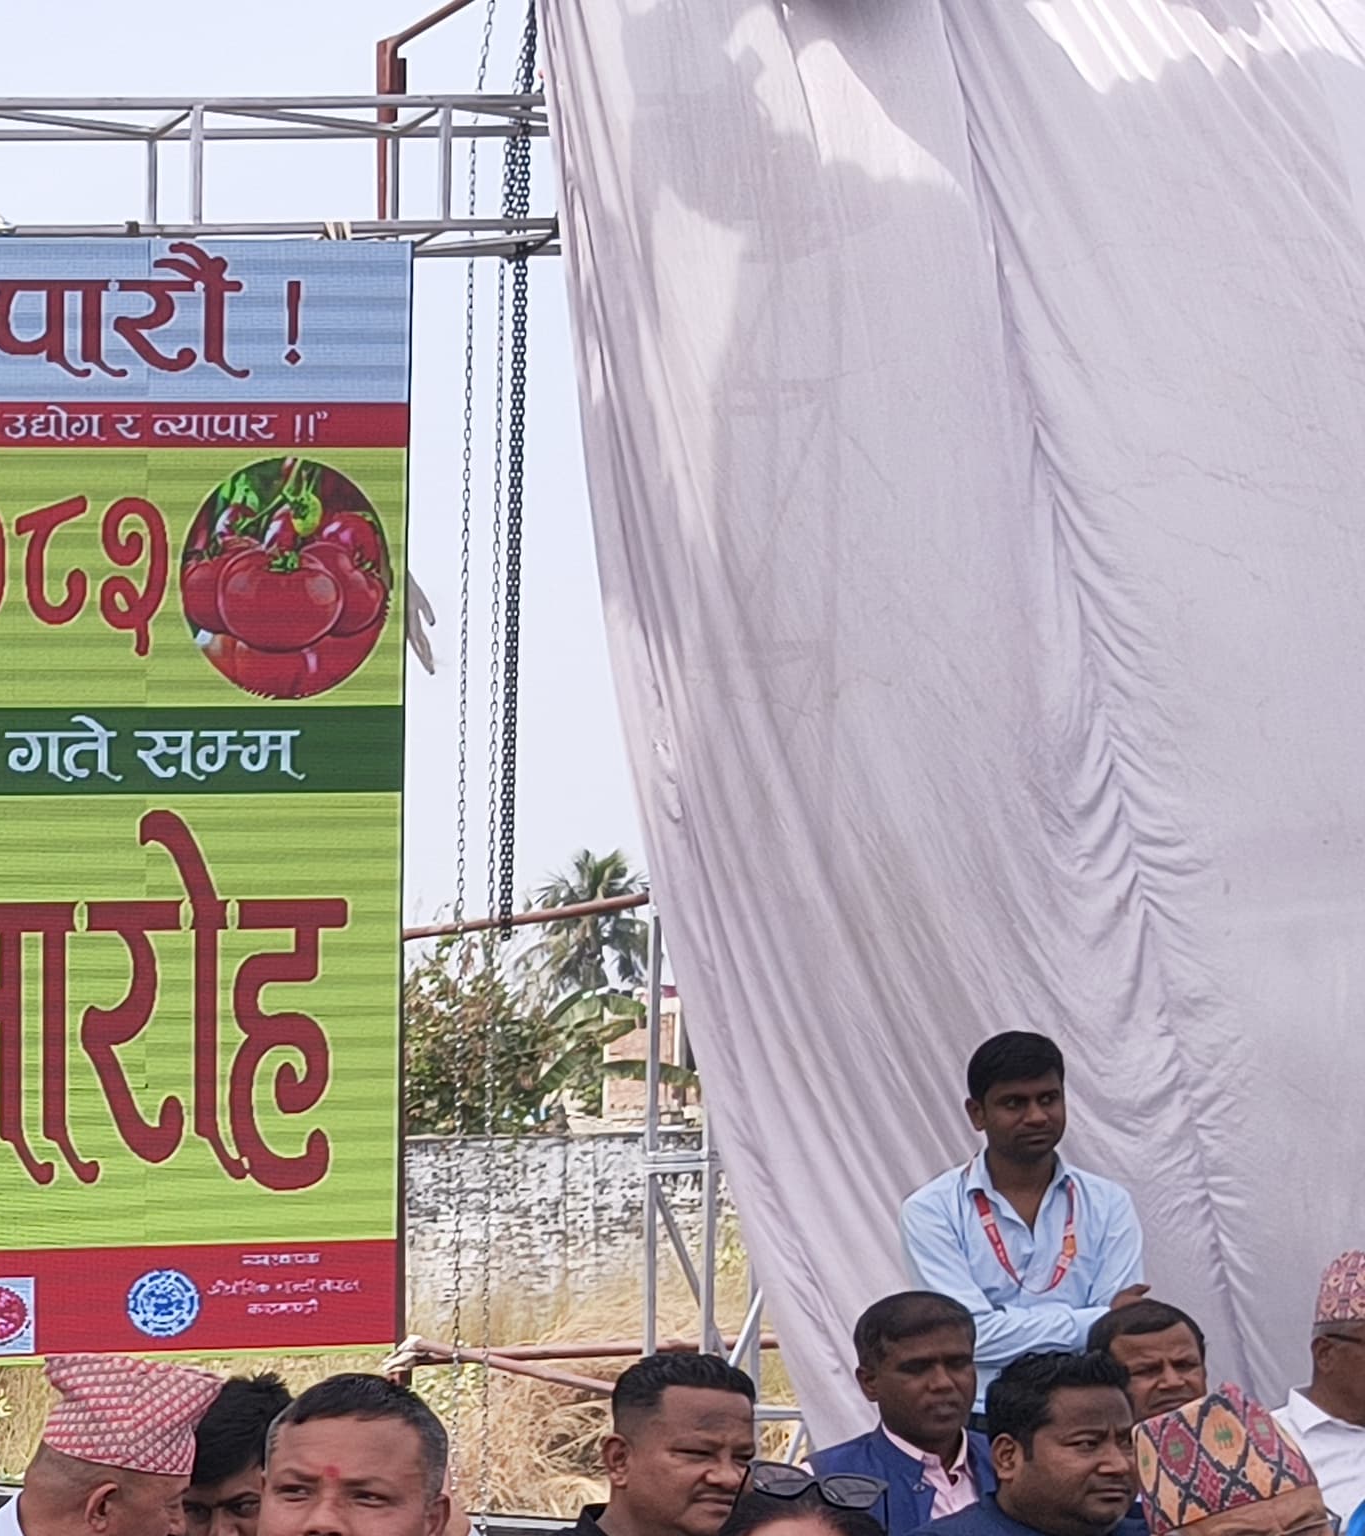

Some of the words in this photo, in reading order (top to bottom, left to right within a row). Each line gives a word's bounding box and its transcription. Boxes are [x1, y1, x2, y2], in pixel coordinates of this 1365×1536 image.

[2, 405, 107, 442] उद्योग
[112, 413, 142, 440] र
[151, 413, 279, 442] व्यापार
[5, 716, 123, 783] गते
[135, 729, 307, 781] सम्म
